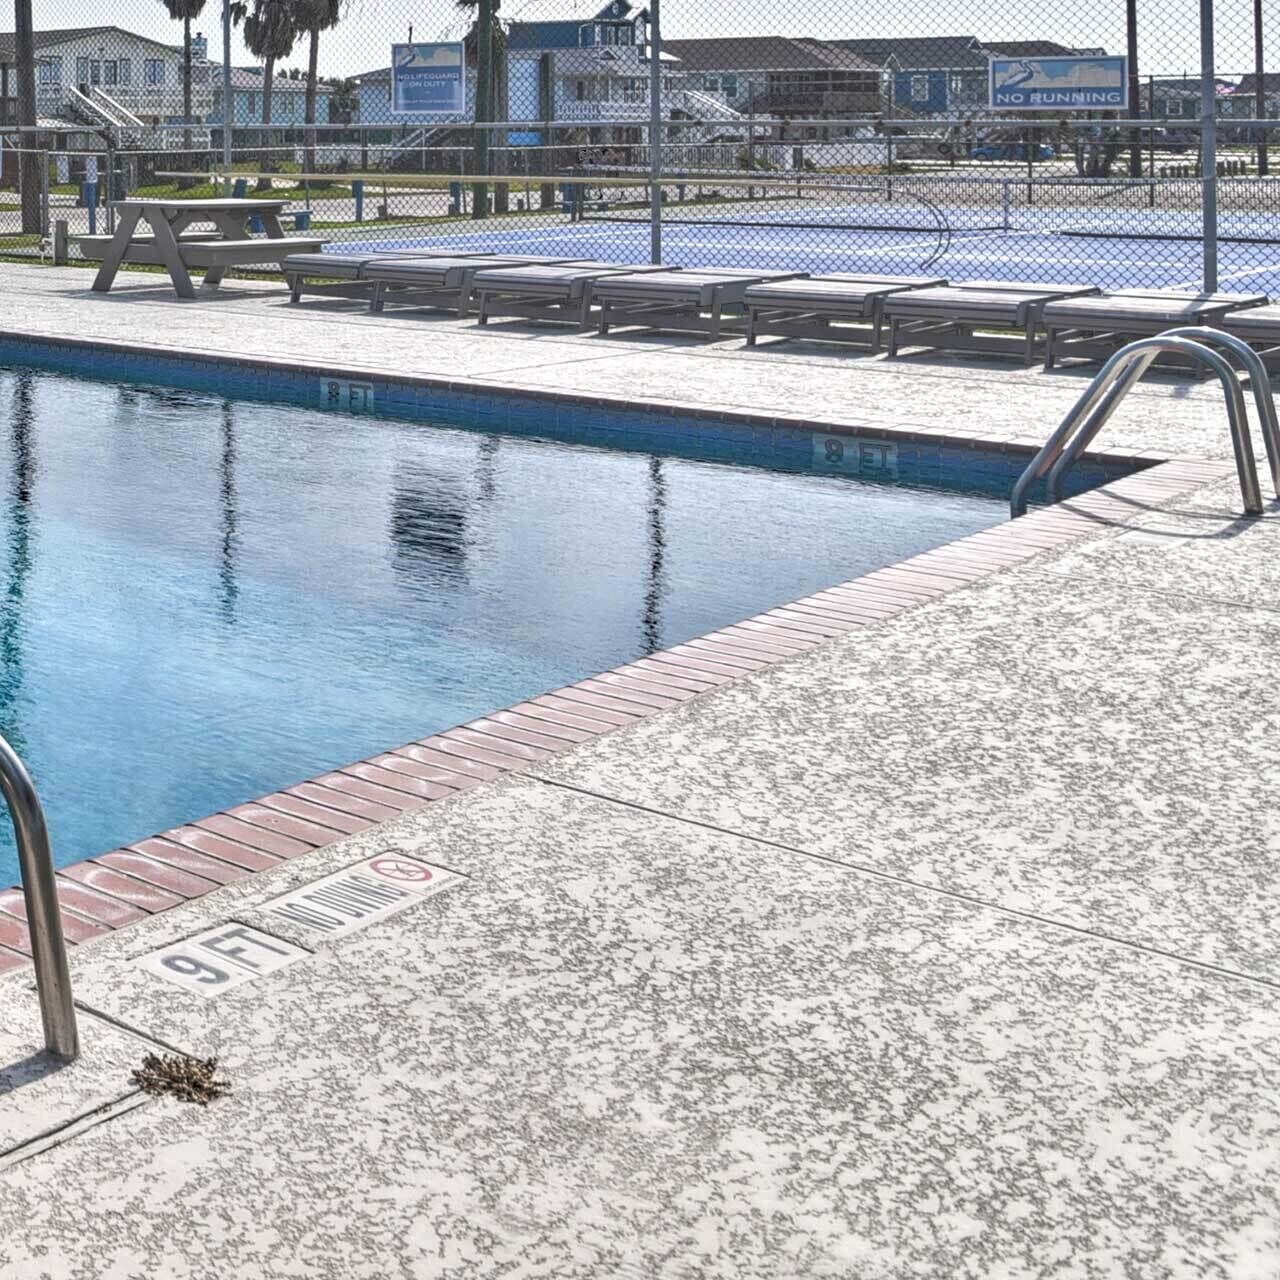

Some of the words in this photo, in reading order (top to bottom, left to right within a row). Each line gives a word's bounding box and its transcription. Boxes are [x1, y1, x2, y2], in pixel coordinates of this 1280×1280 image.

[996, 94, 1024, 103] NO
[1029, 92, 1120, 103] RUNNING
[349, 383, 369, 409] FT
[858, 442, 892, 471] FT
[302, 874, 409, 920] DIVING
[269, 902, 347, 933] NO
[161, 954, 230, 984] 9
[200, 928, 290, 969] FT
